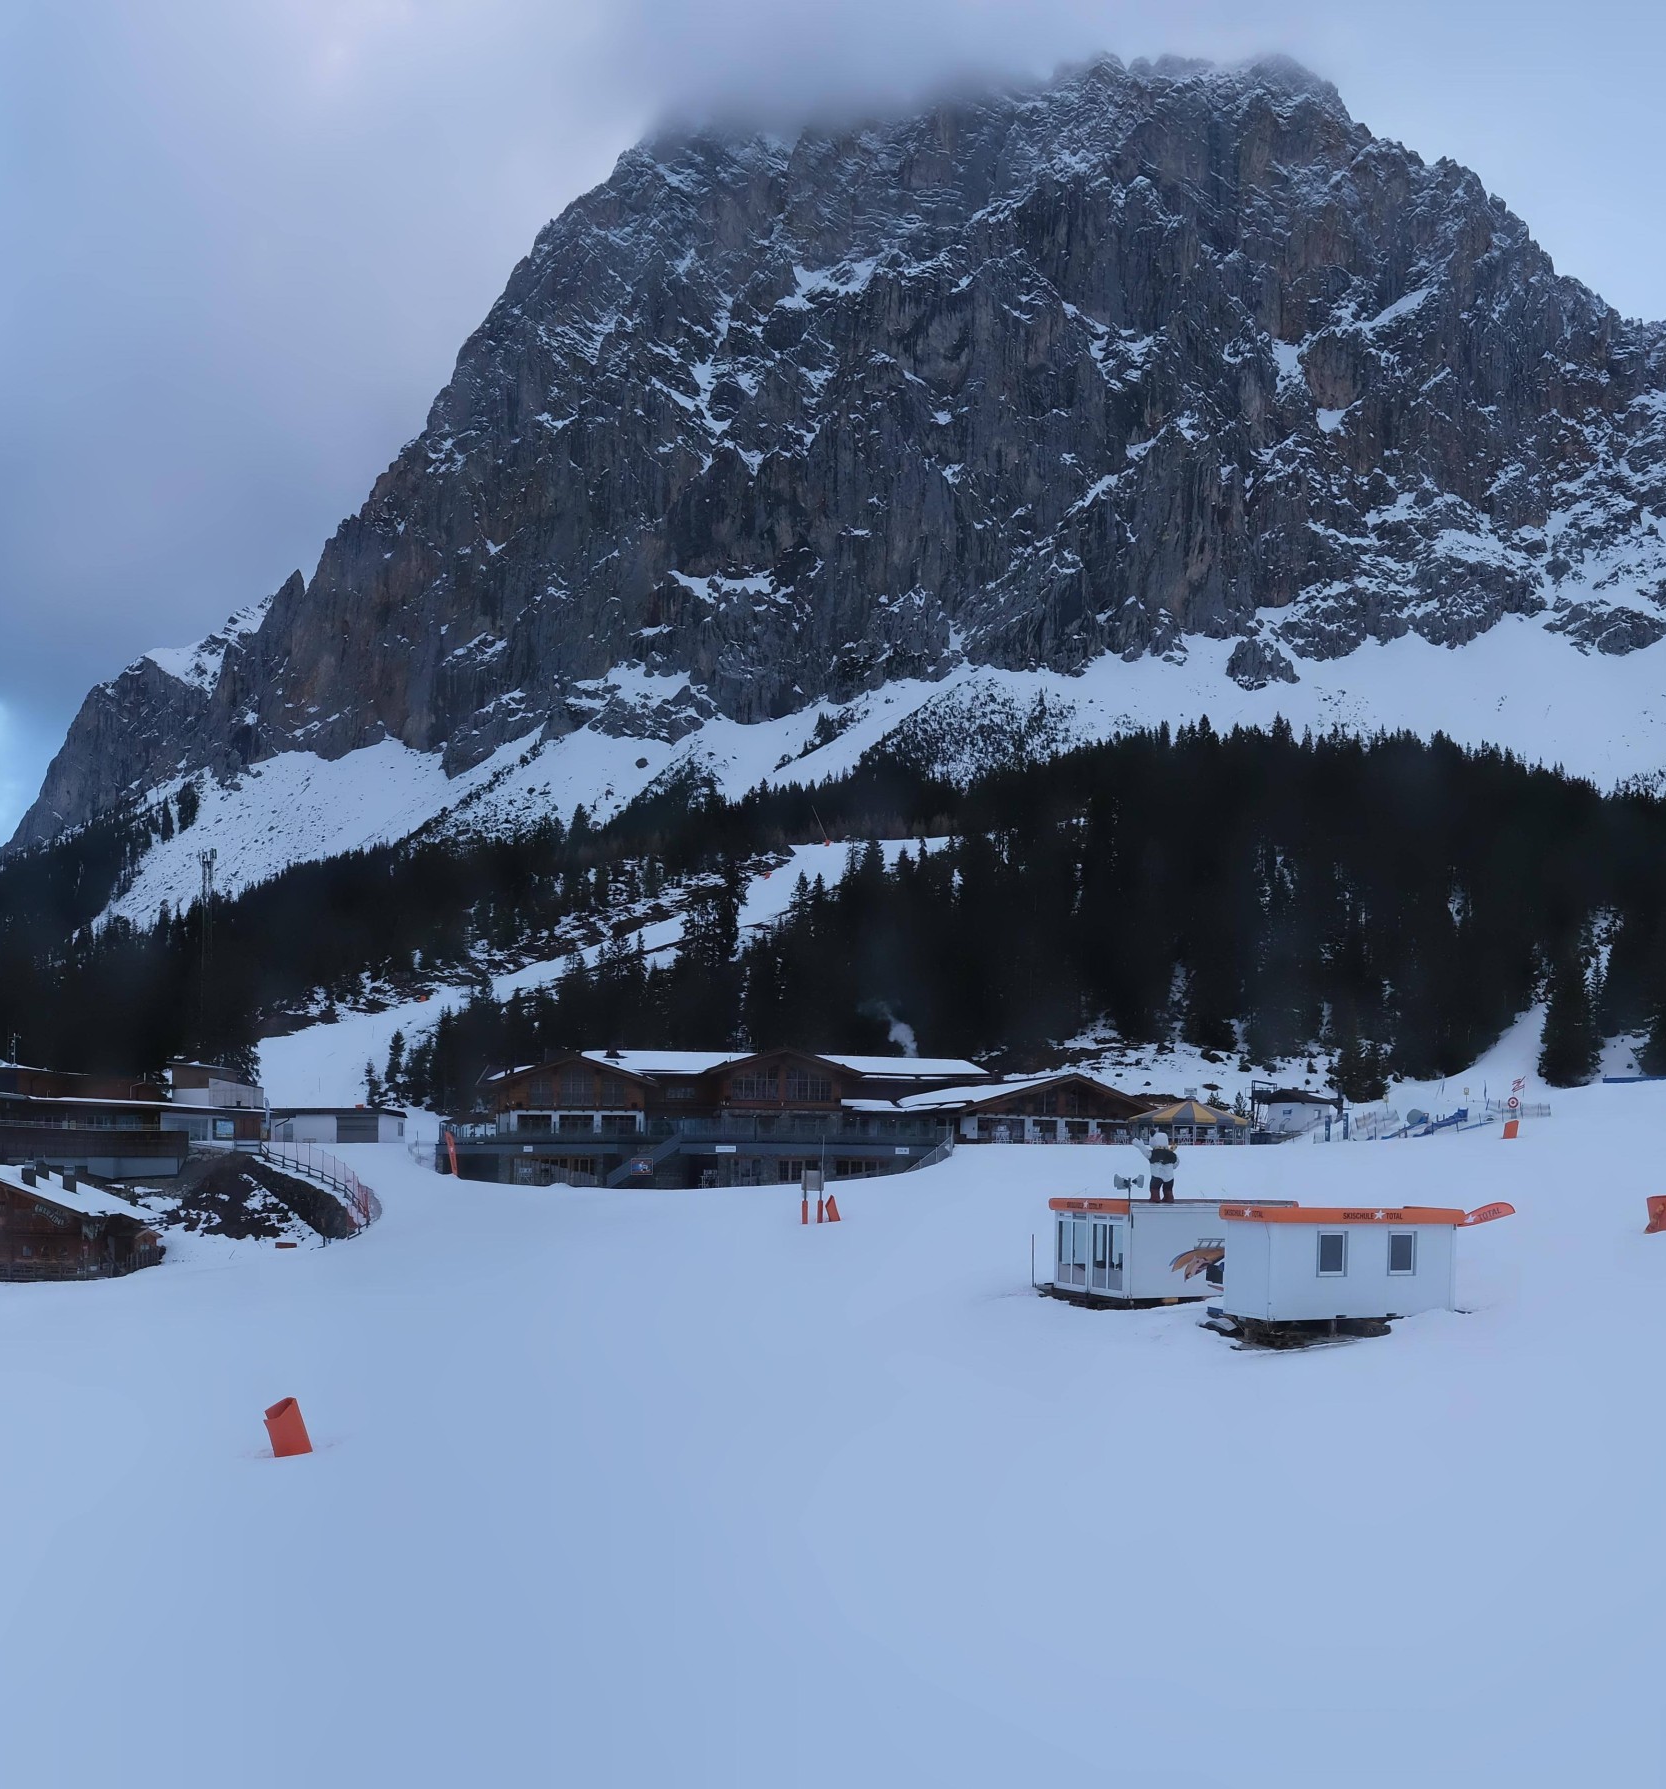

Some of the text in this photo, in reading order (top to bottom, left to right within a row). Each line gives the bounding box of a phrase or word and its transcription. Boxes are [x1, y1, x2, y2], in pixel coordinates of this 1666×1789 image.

[1343, 1212, 1403, 1220] SKISCHULE TOTAL
[1477, 1207, 1502, 1221] TOTAL
